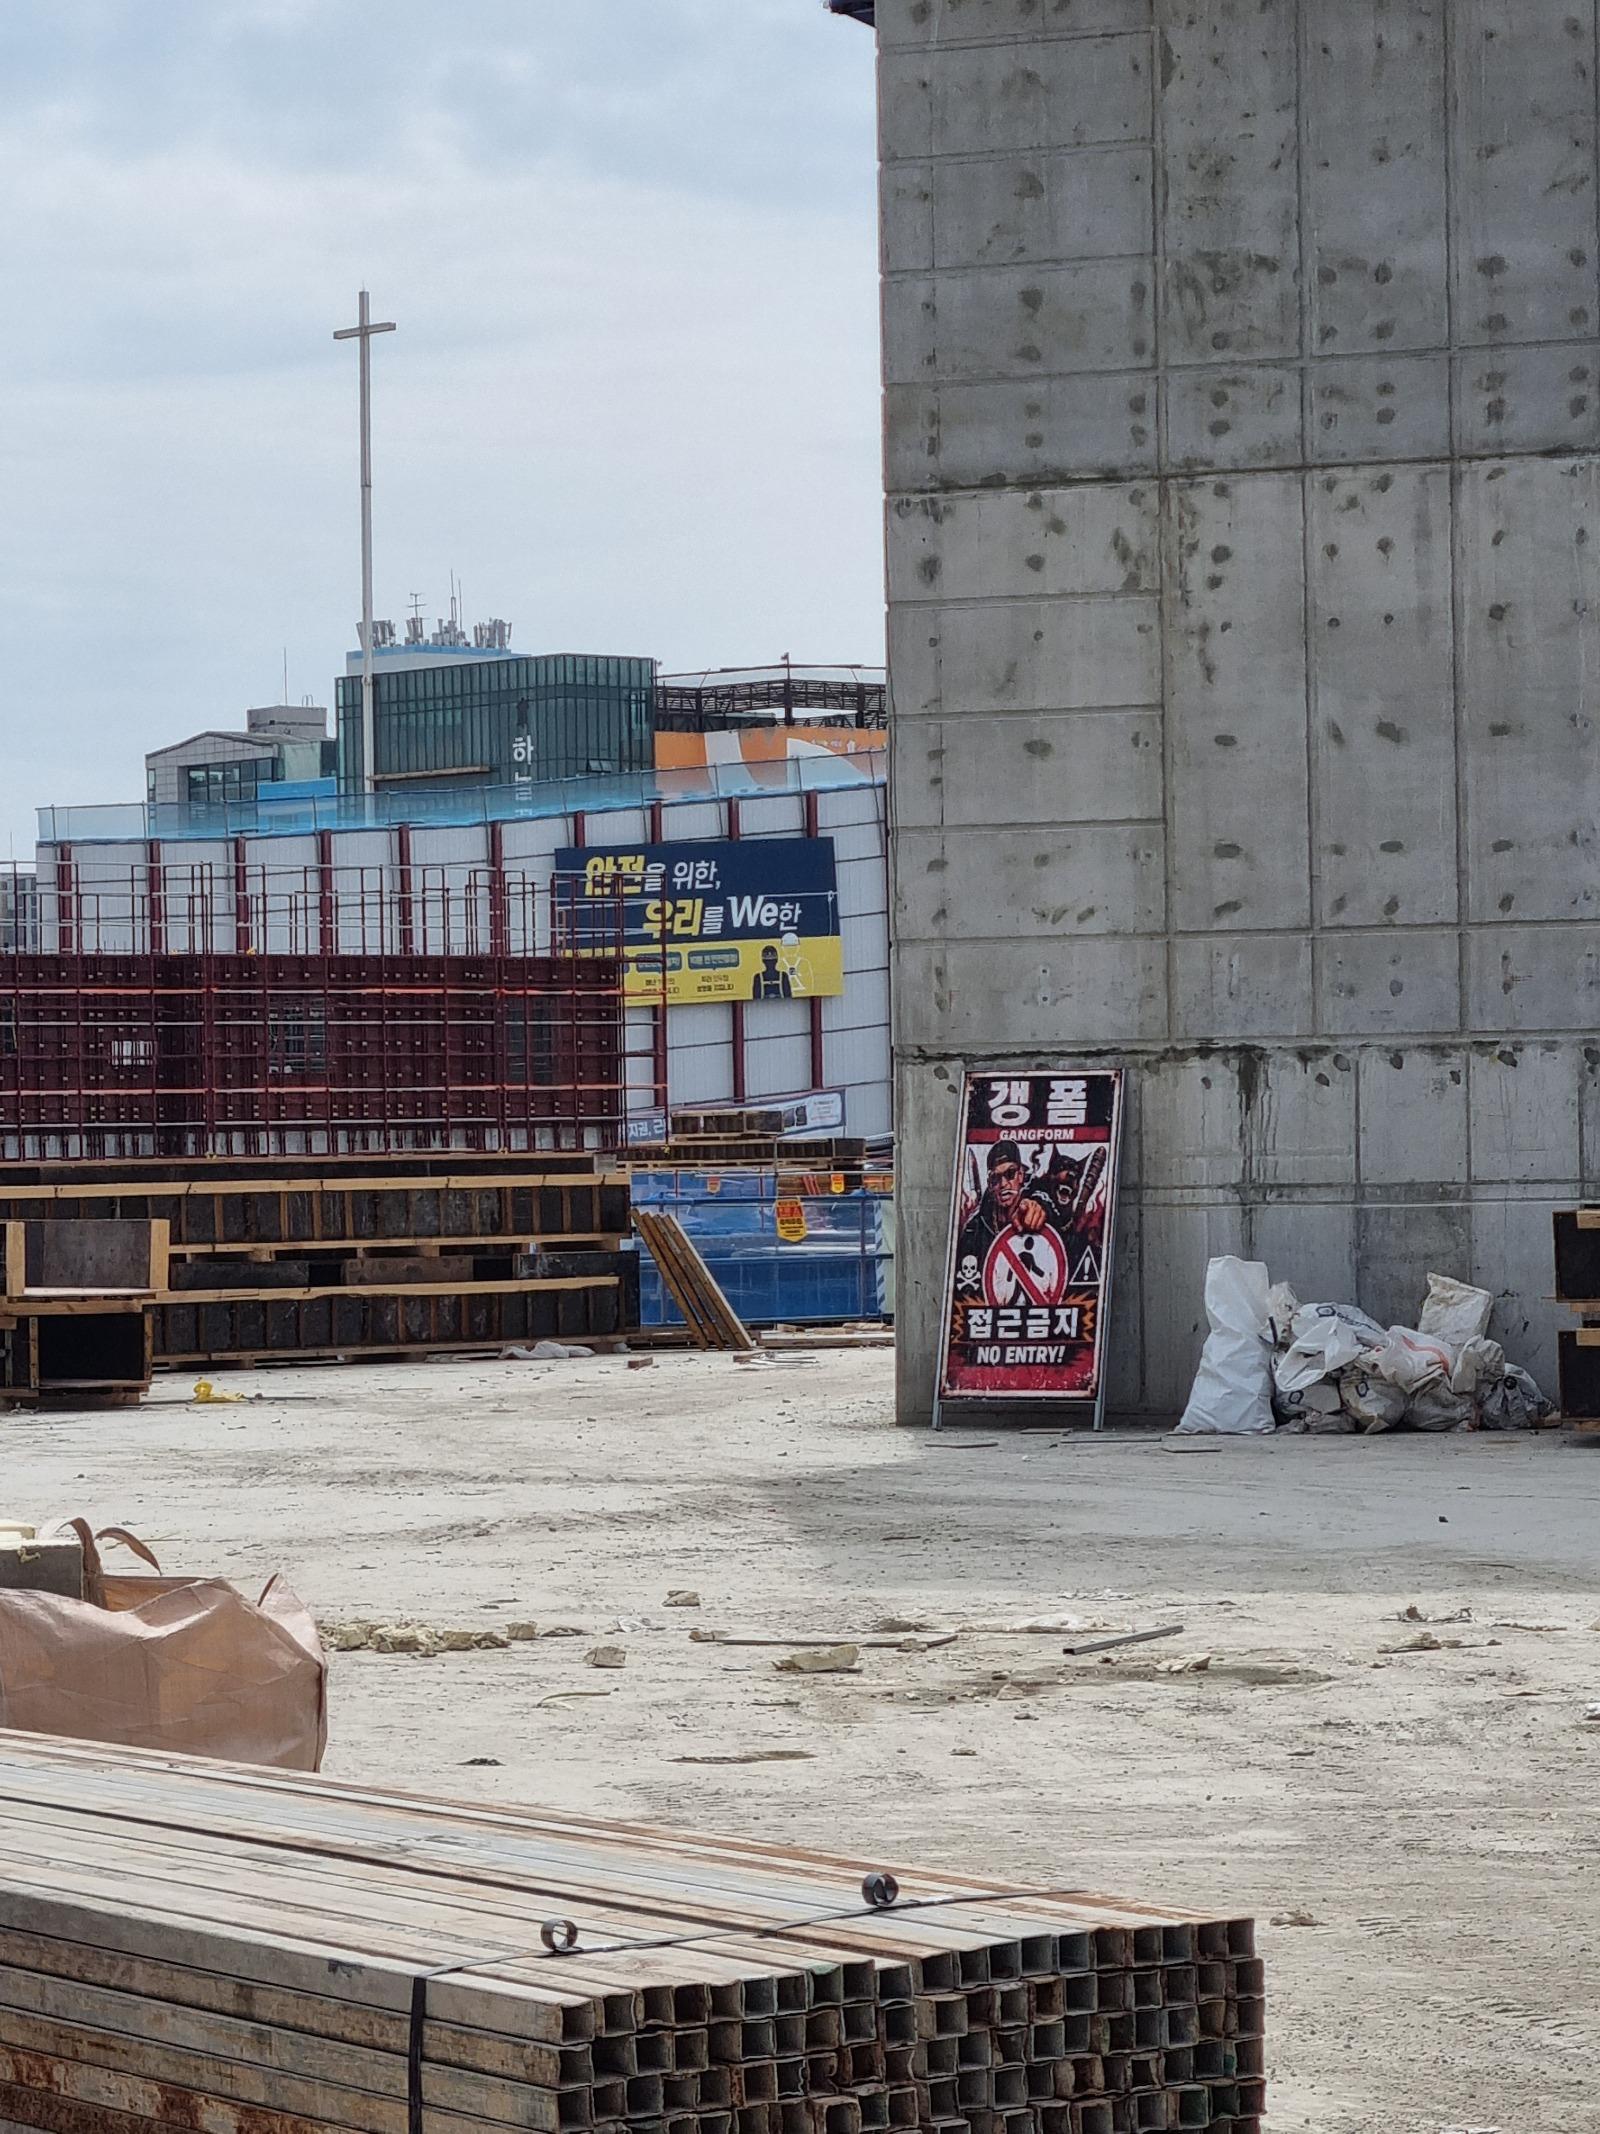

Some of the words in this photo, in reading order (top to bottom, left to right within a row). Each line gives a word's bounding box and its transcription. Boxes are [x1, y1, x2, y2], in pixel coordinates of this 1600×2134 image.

[584, 854, 666, 897] 안전을
[672, 860, 721, 890] 위한,
[642, 898, 724, 939] 우리를
[726, 895, 802, 932] We한
[999, 1129, 1075, 1141] GANGFORM
[967, 1307, 1079, 1339] 접근금지
[976, 1346, 1001, 1365] NO
[1005, 1345, 1066, 1364] ENTRY!
